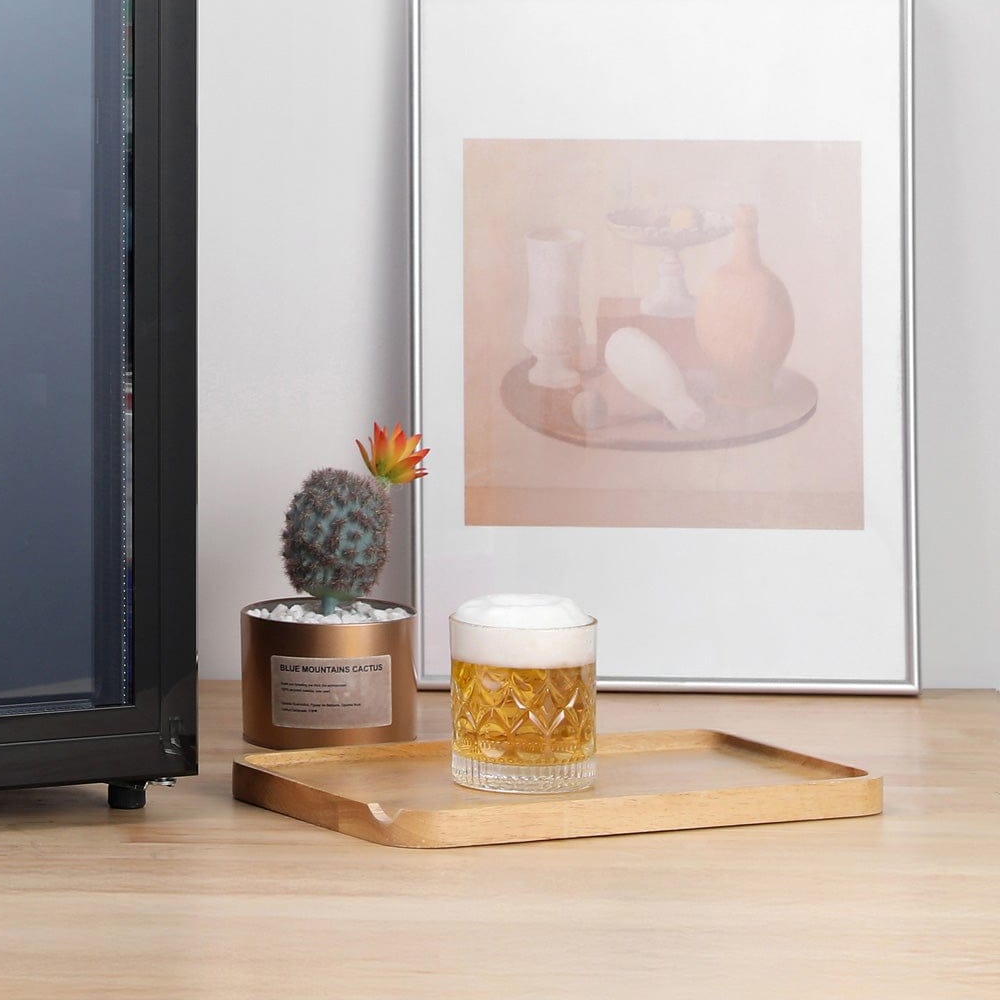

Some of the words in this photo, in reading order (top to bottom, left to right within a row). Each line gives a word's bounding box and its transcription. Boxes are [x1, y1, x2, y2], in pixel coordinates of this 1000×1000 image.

[280, 664, 300, 673] BLUE
[301, 666, 350, 674] MOUNTAINS
[352, 664, 383, 673] CACTUS
